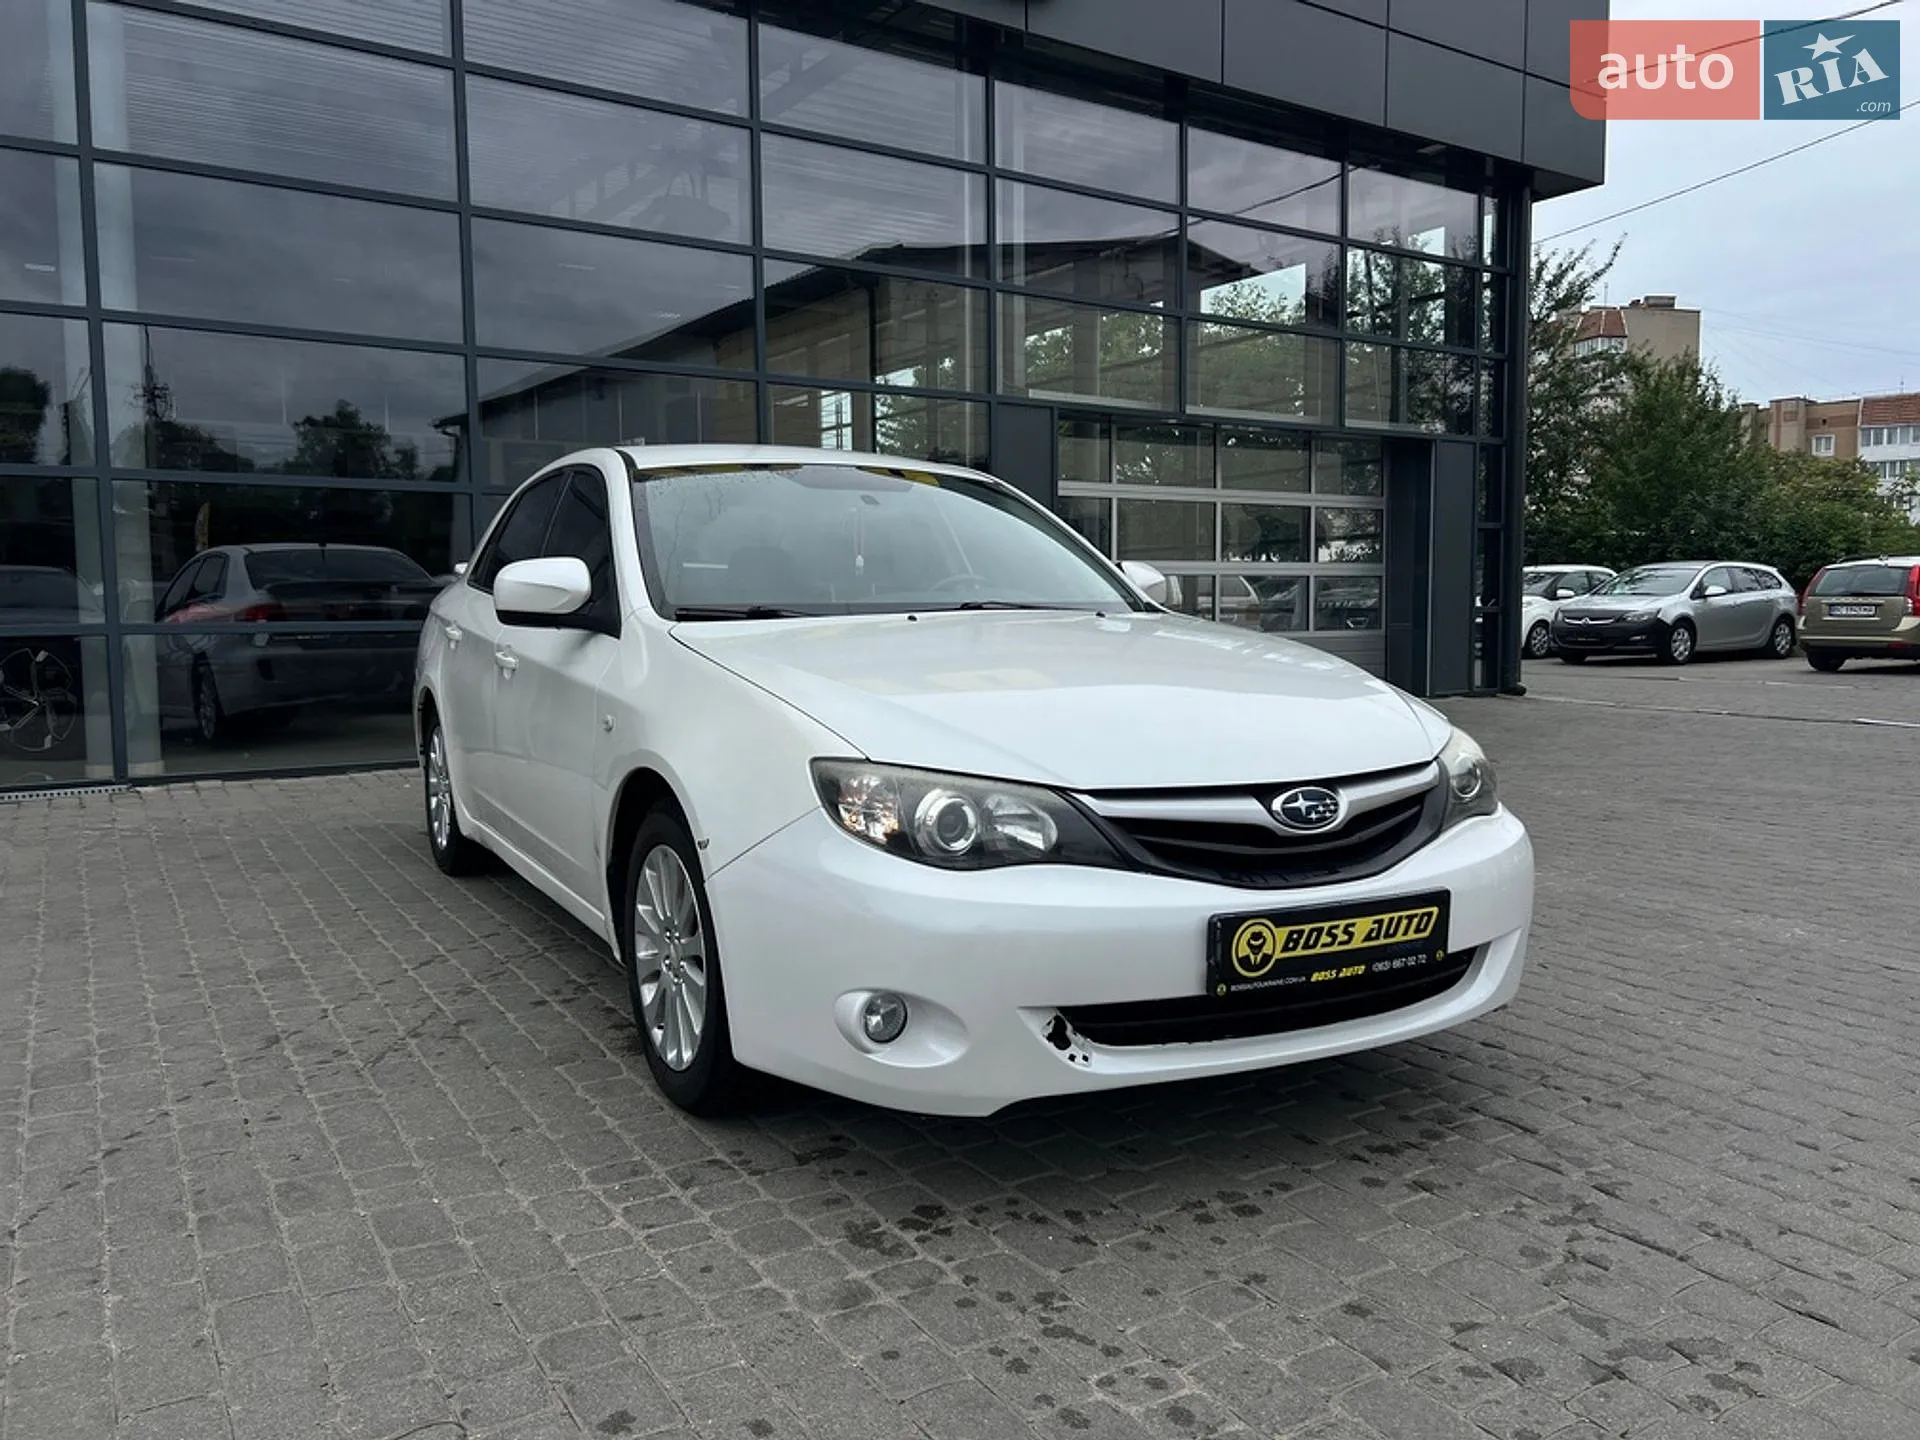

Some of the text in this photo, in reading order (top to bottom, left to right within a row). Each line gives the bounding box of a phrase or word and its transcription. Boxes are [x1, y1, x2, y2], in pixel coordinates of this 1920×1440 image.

[1280, 910, 1434, 953] BOSS AUTO
[1310, 970, 1337, 982] BOSS
[1338, 965, 1366, 978] AUTO
